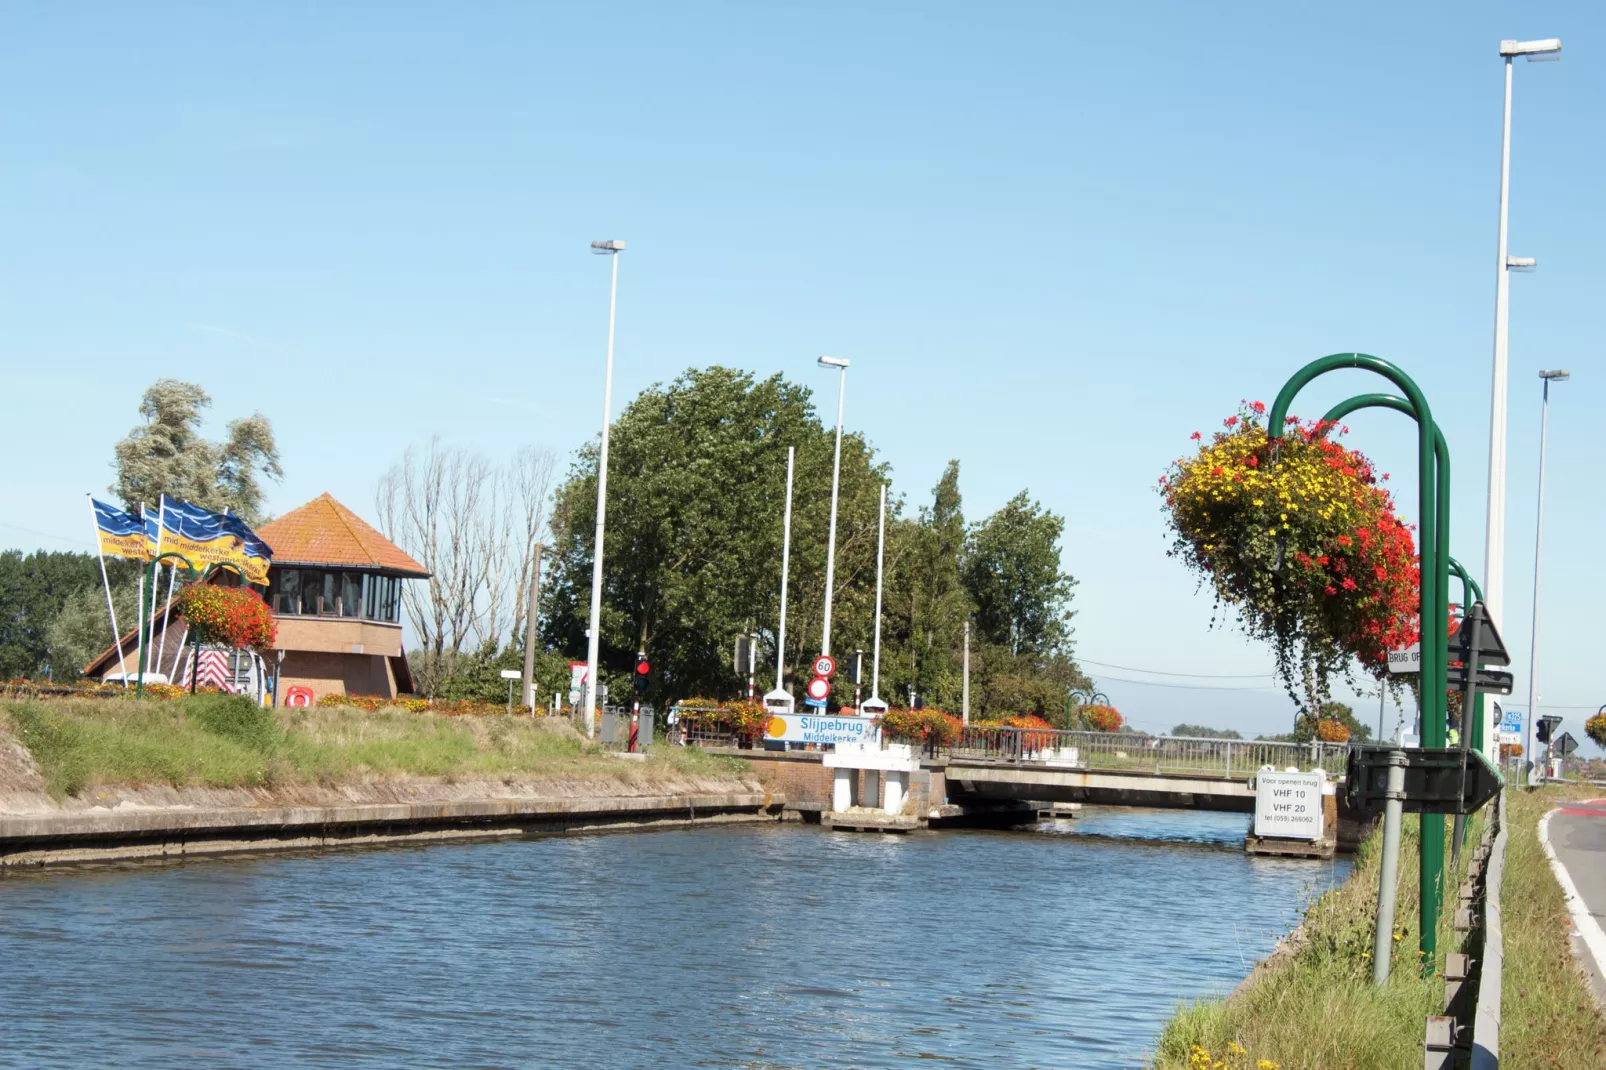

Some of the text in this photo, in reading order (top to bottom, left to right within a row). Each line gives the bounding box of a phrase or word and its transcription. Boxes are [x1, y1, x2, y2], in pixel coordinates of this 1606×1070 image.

[179, 542, 229, 556] middelkerke
[1389, 652, 1409, 663] BRUG
[817, 661, 831, 672] 60
[800, 716, 863, 734] Slijpebrug
[803, 732, 857, 743] Middelkerke
[1302, 779, 1318, 788] brug
[1273, 789, 1306, 799] VHF 10
[1273, 803, 1306, 813] VHF 20
